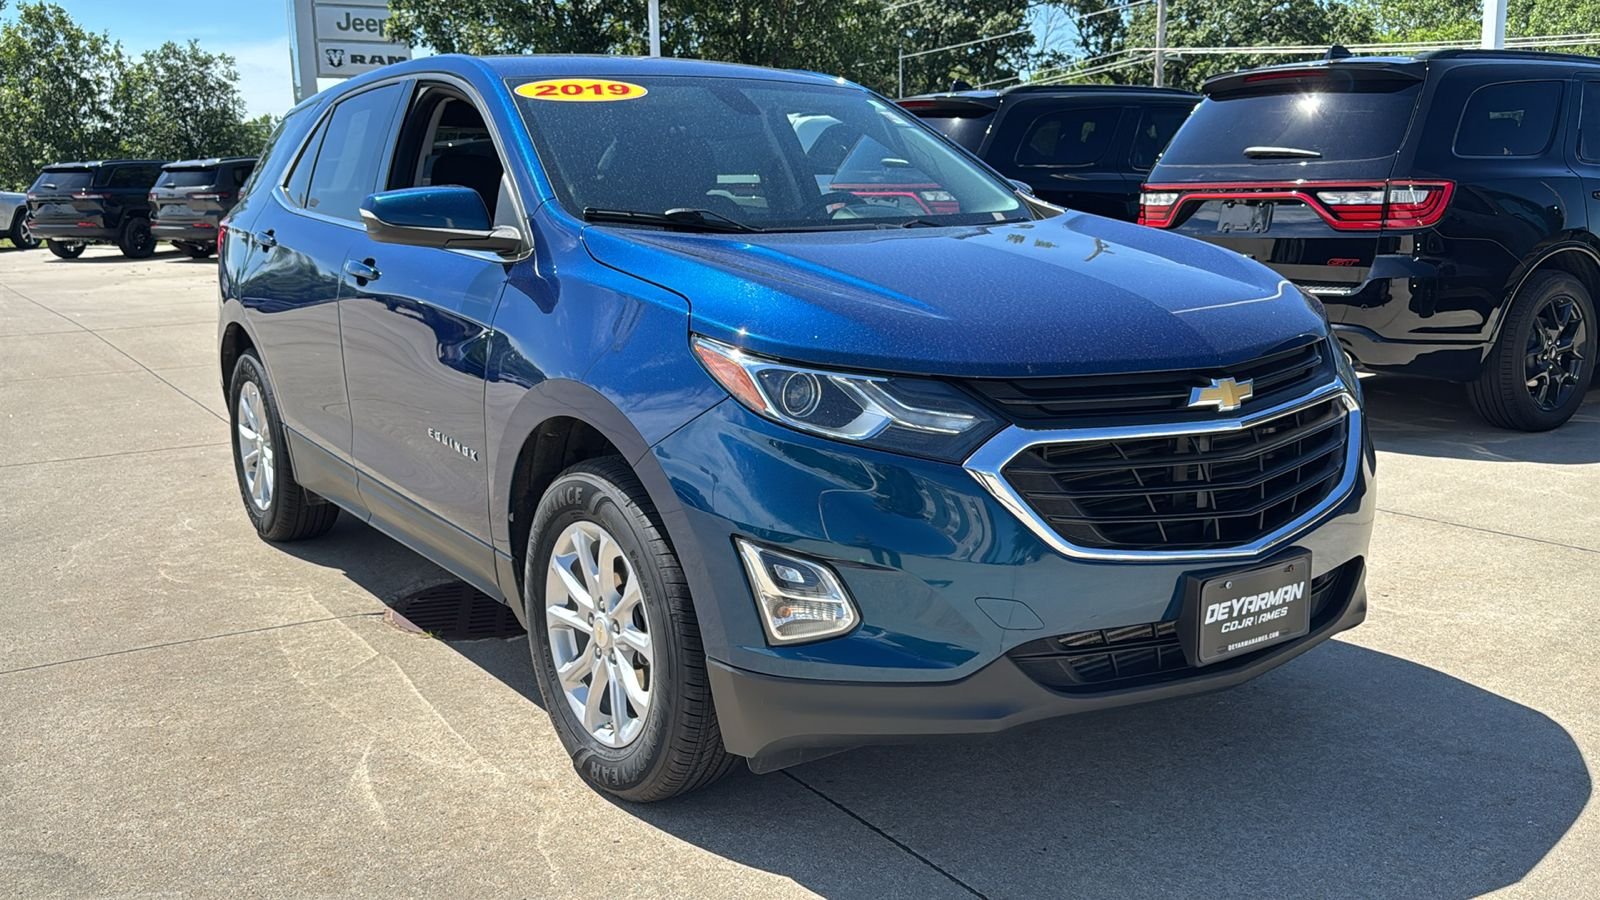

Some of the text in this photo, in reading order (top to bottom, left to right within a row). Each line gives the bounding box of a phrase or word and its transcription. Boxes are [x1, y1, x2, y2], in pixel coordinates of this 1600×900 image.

[350, 54, 407, 65] RAM
[535, 84, 630, 96] 2019
[427, 427, 478, 462] EQUINOX
[1204, 581, 1305, 625] DEYARMAN
[1221, 606, 1289, 633] CDJR AMES
